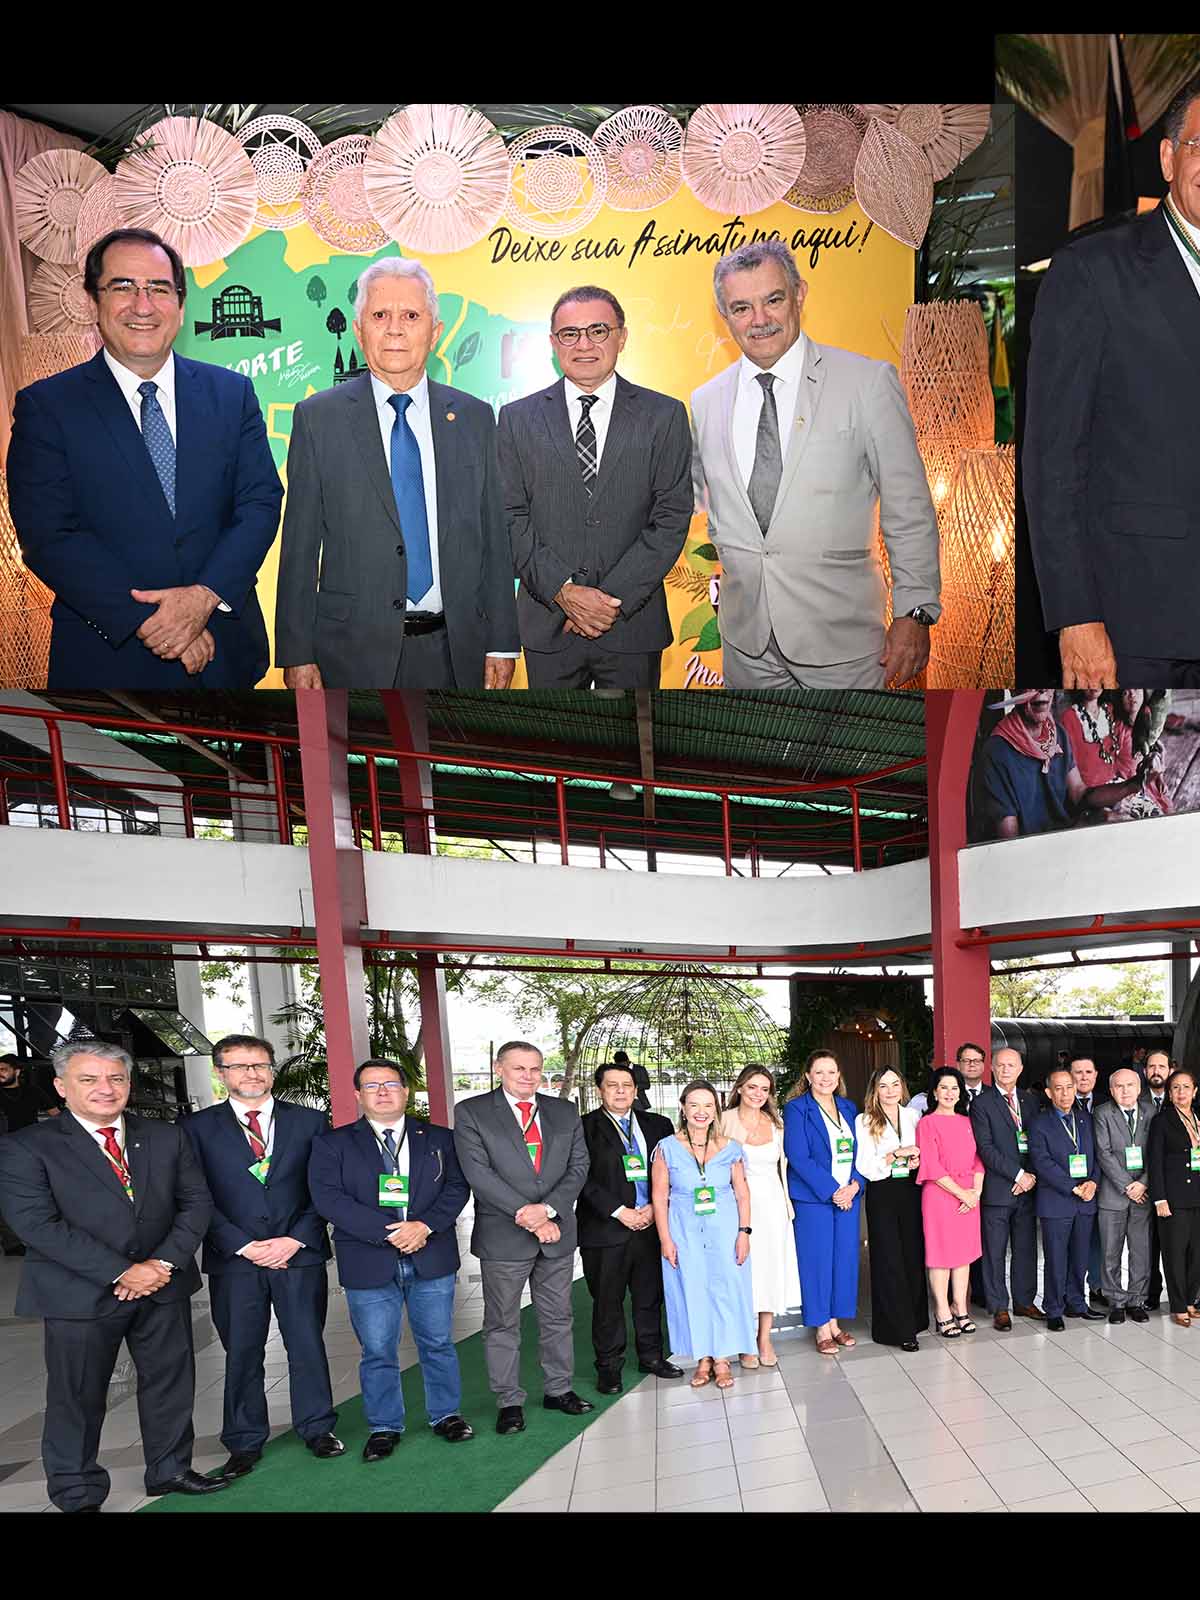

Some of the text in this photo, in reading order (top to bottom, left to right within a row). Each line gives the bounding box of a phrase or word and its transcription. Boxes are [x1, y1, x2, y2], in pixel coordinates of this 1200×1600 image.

[488, 226, 568, 265] Deixe
[571, 235, 625, 262] sua
[791, 220, 875, 270] aqui!
[226, 340, 304, 378] ORTE
